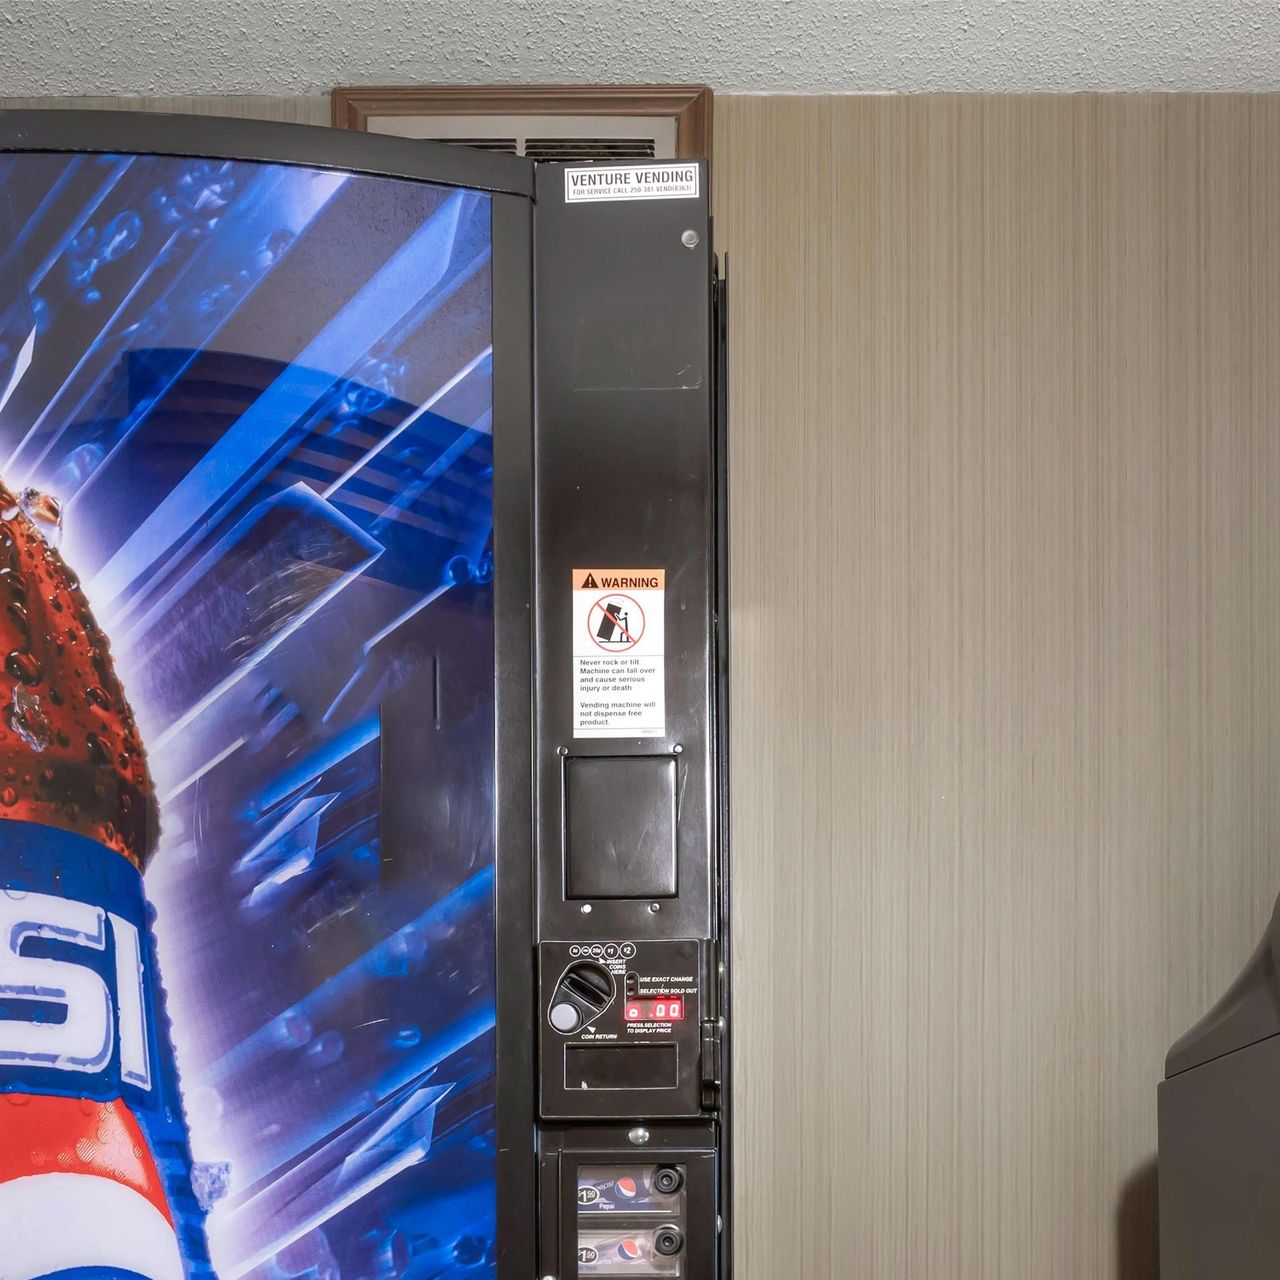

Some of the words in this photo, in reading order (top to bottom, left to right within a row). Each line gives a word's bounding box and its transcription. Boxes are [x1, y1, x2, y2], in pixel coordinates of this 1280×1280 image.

[572, 173, 630, 186] VENTURE
[636, 170, 693, 183] VENDING
[601, 578, 658, 588] WARNING
